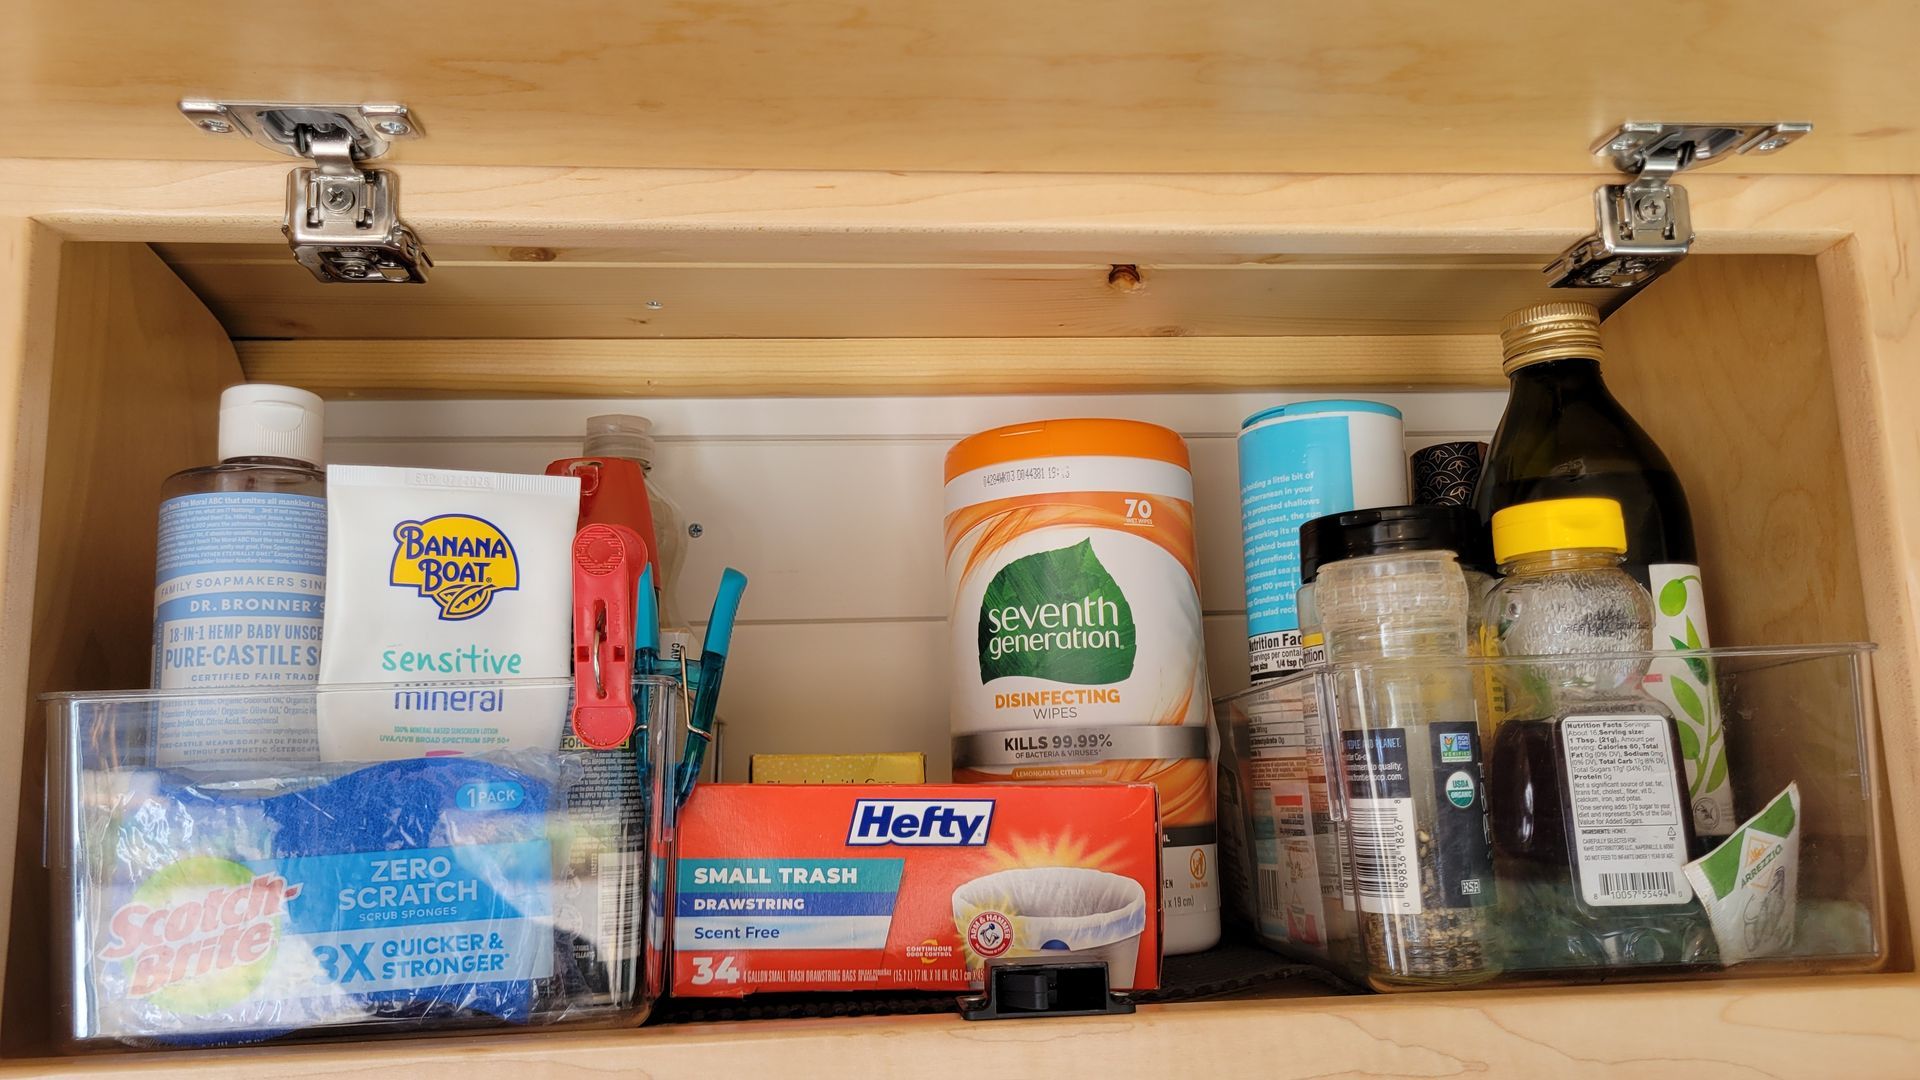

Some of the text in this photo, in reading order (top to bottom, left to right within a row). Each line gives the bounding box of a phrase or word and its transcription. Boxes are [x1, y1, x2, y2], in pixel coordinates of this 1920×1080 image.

[1295, 486, 1313, 495] your
[1124, 498, 1152, 519] 70
[1284, 498, 1320, 508] shallows
[399, 525, 507, 560] BANANA
[161, 580, 192, 597] FAMILY
[195, 575, 295, 589] SOAPMAKERS
[418, 558, 491, 592] BOAT
[190, 600, 217, 613] DR.
[987, 595, 1119, 635] seventh
[169, 624, 205, 644] 18-IN-1
[208, 623, 243, 640] HEMP
[247, 623, 281, 641] BABY
[165, 644, 302, 671] PURE-CASTILE
[381, 643, 522, 675] sensitive
[191, 672, 321, 682] CERTIFIED FAIR TRADE
[394, 688, 503, 713] mineral
[995, 688, 1121, 710] DISINFECTING
[1032, 706, 1078, 720] WIPES
[1567, 721, 1600, 729] Nutrition
[1004, 733, 1113, 752] KILLS 99.99%
[1025, 750, 1059, 759] BACTERIA
[1452, 780, 1469, 788] USDA
[467, 788, 516, 808] 1 PACK
[857, 805, 985, 845] Hefty
[1393, 816, 1406, 850] 18267
[370, 856, 452, 883] ZERO
[694, 867, 857, 885] SMALL TRASH
[1397, 855, 1409, 889] 89836
[1740, 844, 1783, 889] ARREZZIO
[338, 879, 478, 912] SCRATCH
[693, 898, 805, 911] DRAWSTRING
[1610, 890, 1639, 900] 10057
[1642, 889, 1668, 899] 55494
[359, 906, 457, 922] SCRUB SPONGES
[694, 926, 780, 940] Scent Free
[986, 914, 1011, 940] HAMMER
[128, 921, 274, 996] Brite
[313, 932, 504, 985] 3X QUICKER &
[691, 956, 740, 985] 34
[747, 969, 768, 984] GALLON
[768, 969, 786, 983] SMALL
[787, 969, 805, 983] TRASH
[805, 968, 841, 983] DRAWSTRING
[845, 968, 857, 982] BAGS
